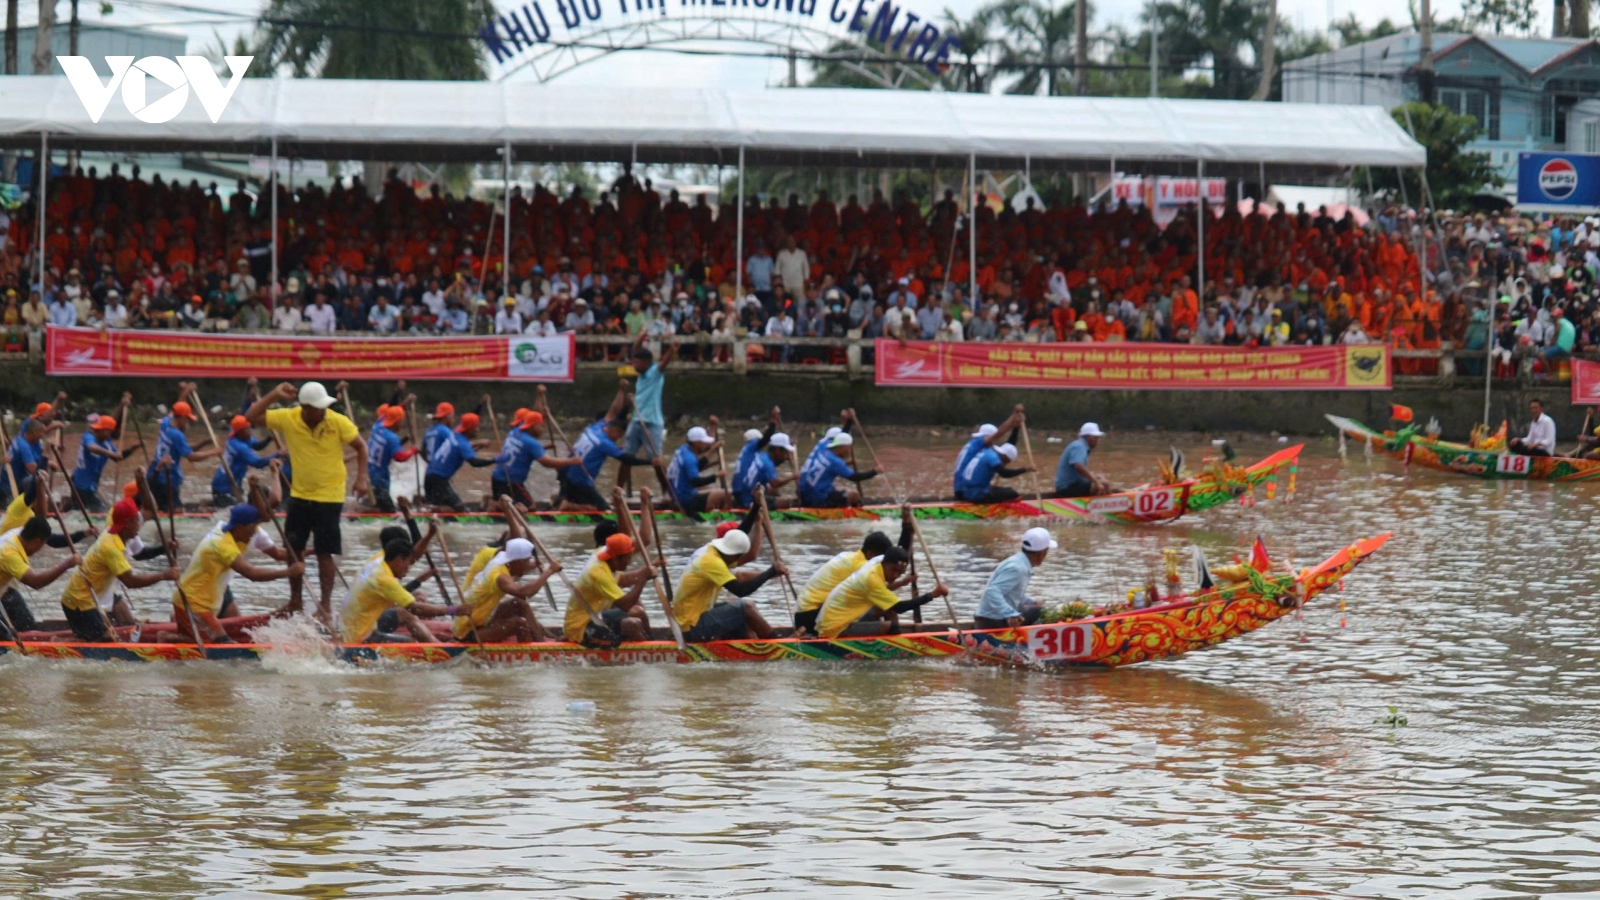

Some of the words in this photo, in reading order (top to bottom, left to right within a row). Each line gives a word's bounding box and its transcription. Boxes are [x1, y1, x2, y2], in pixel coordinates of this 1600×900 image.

[478, 2, 550, 62] KHU
[1542, 174, 1575, 183] PEPSI
[1502, 455, 1525, 472] 18
[1138, 491, 1170, 513] 02
[1034, 626, 1085, 659] 30
